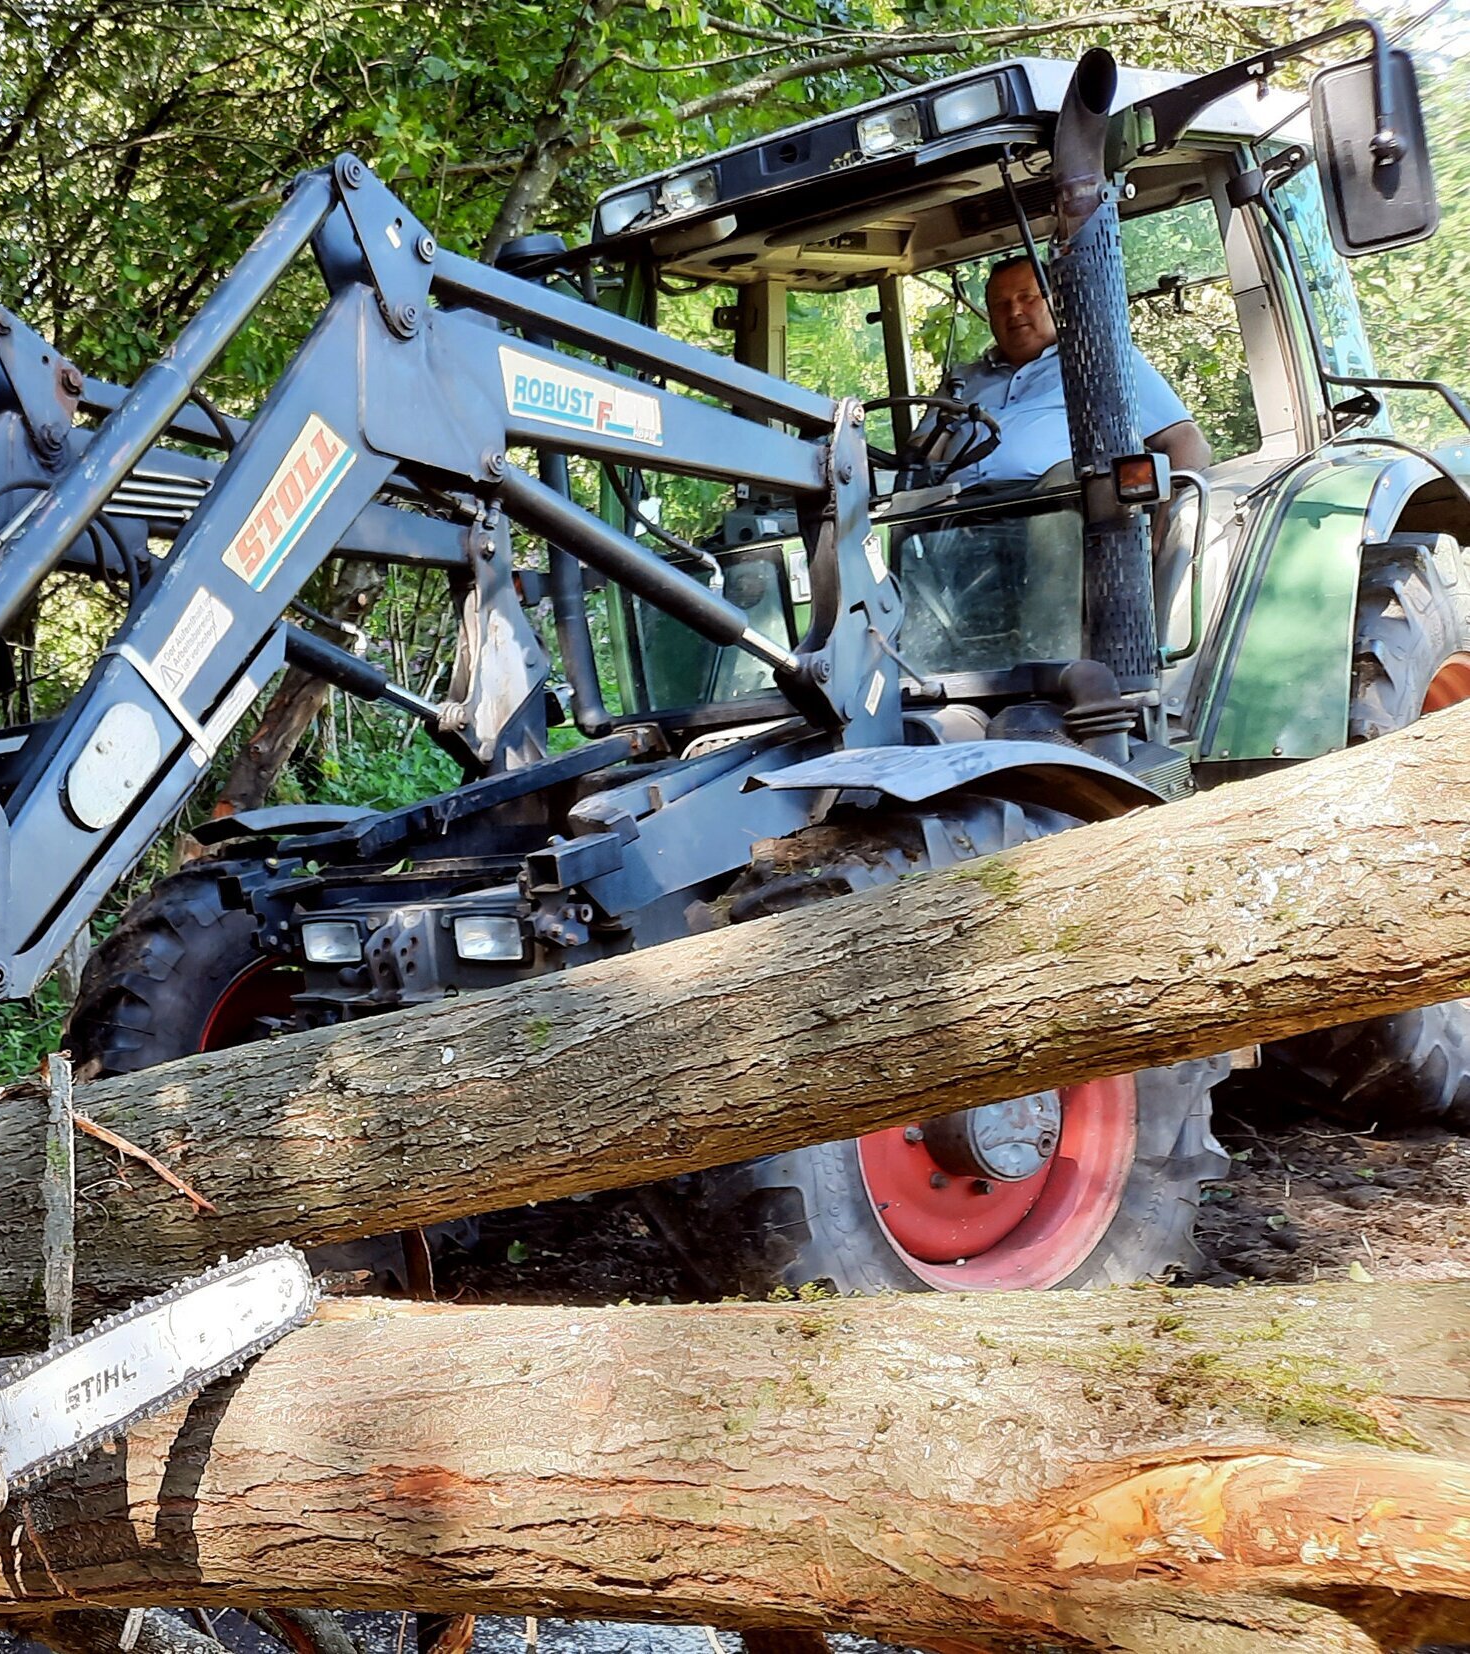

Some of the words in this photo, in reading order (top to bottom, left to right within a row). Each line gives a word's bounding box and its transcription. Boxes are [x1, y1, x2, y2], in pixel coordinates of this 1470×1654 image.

[513, 374, 595, 416] ROBUST
[596, 400, 613, 430] F
[234, 427, 339, 577] STOLL
[65, 1360, 138, 1414] STIHL
